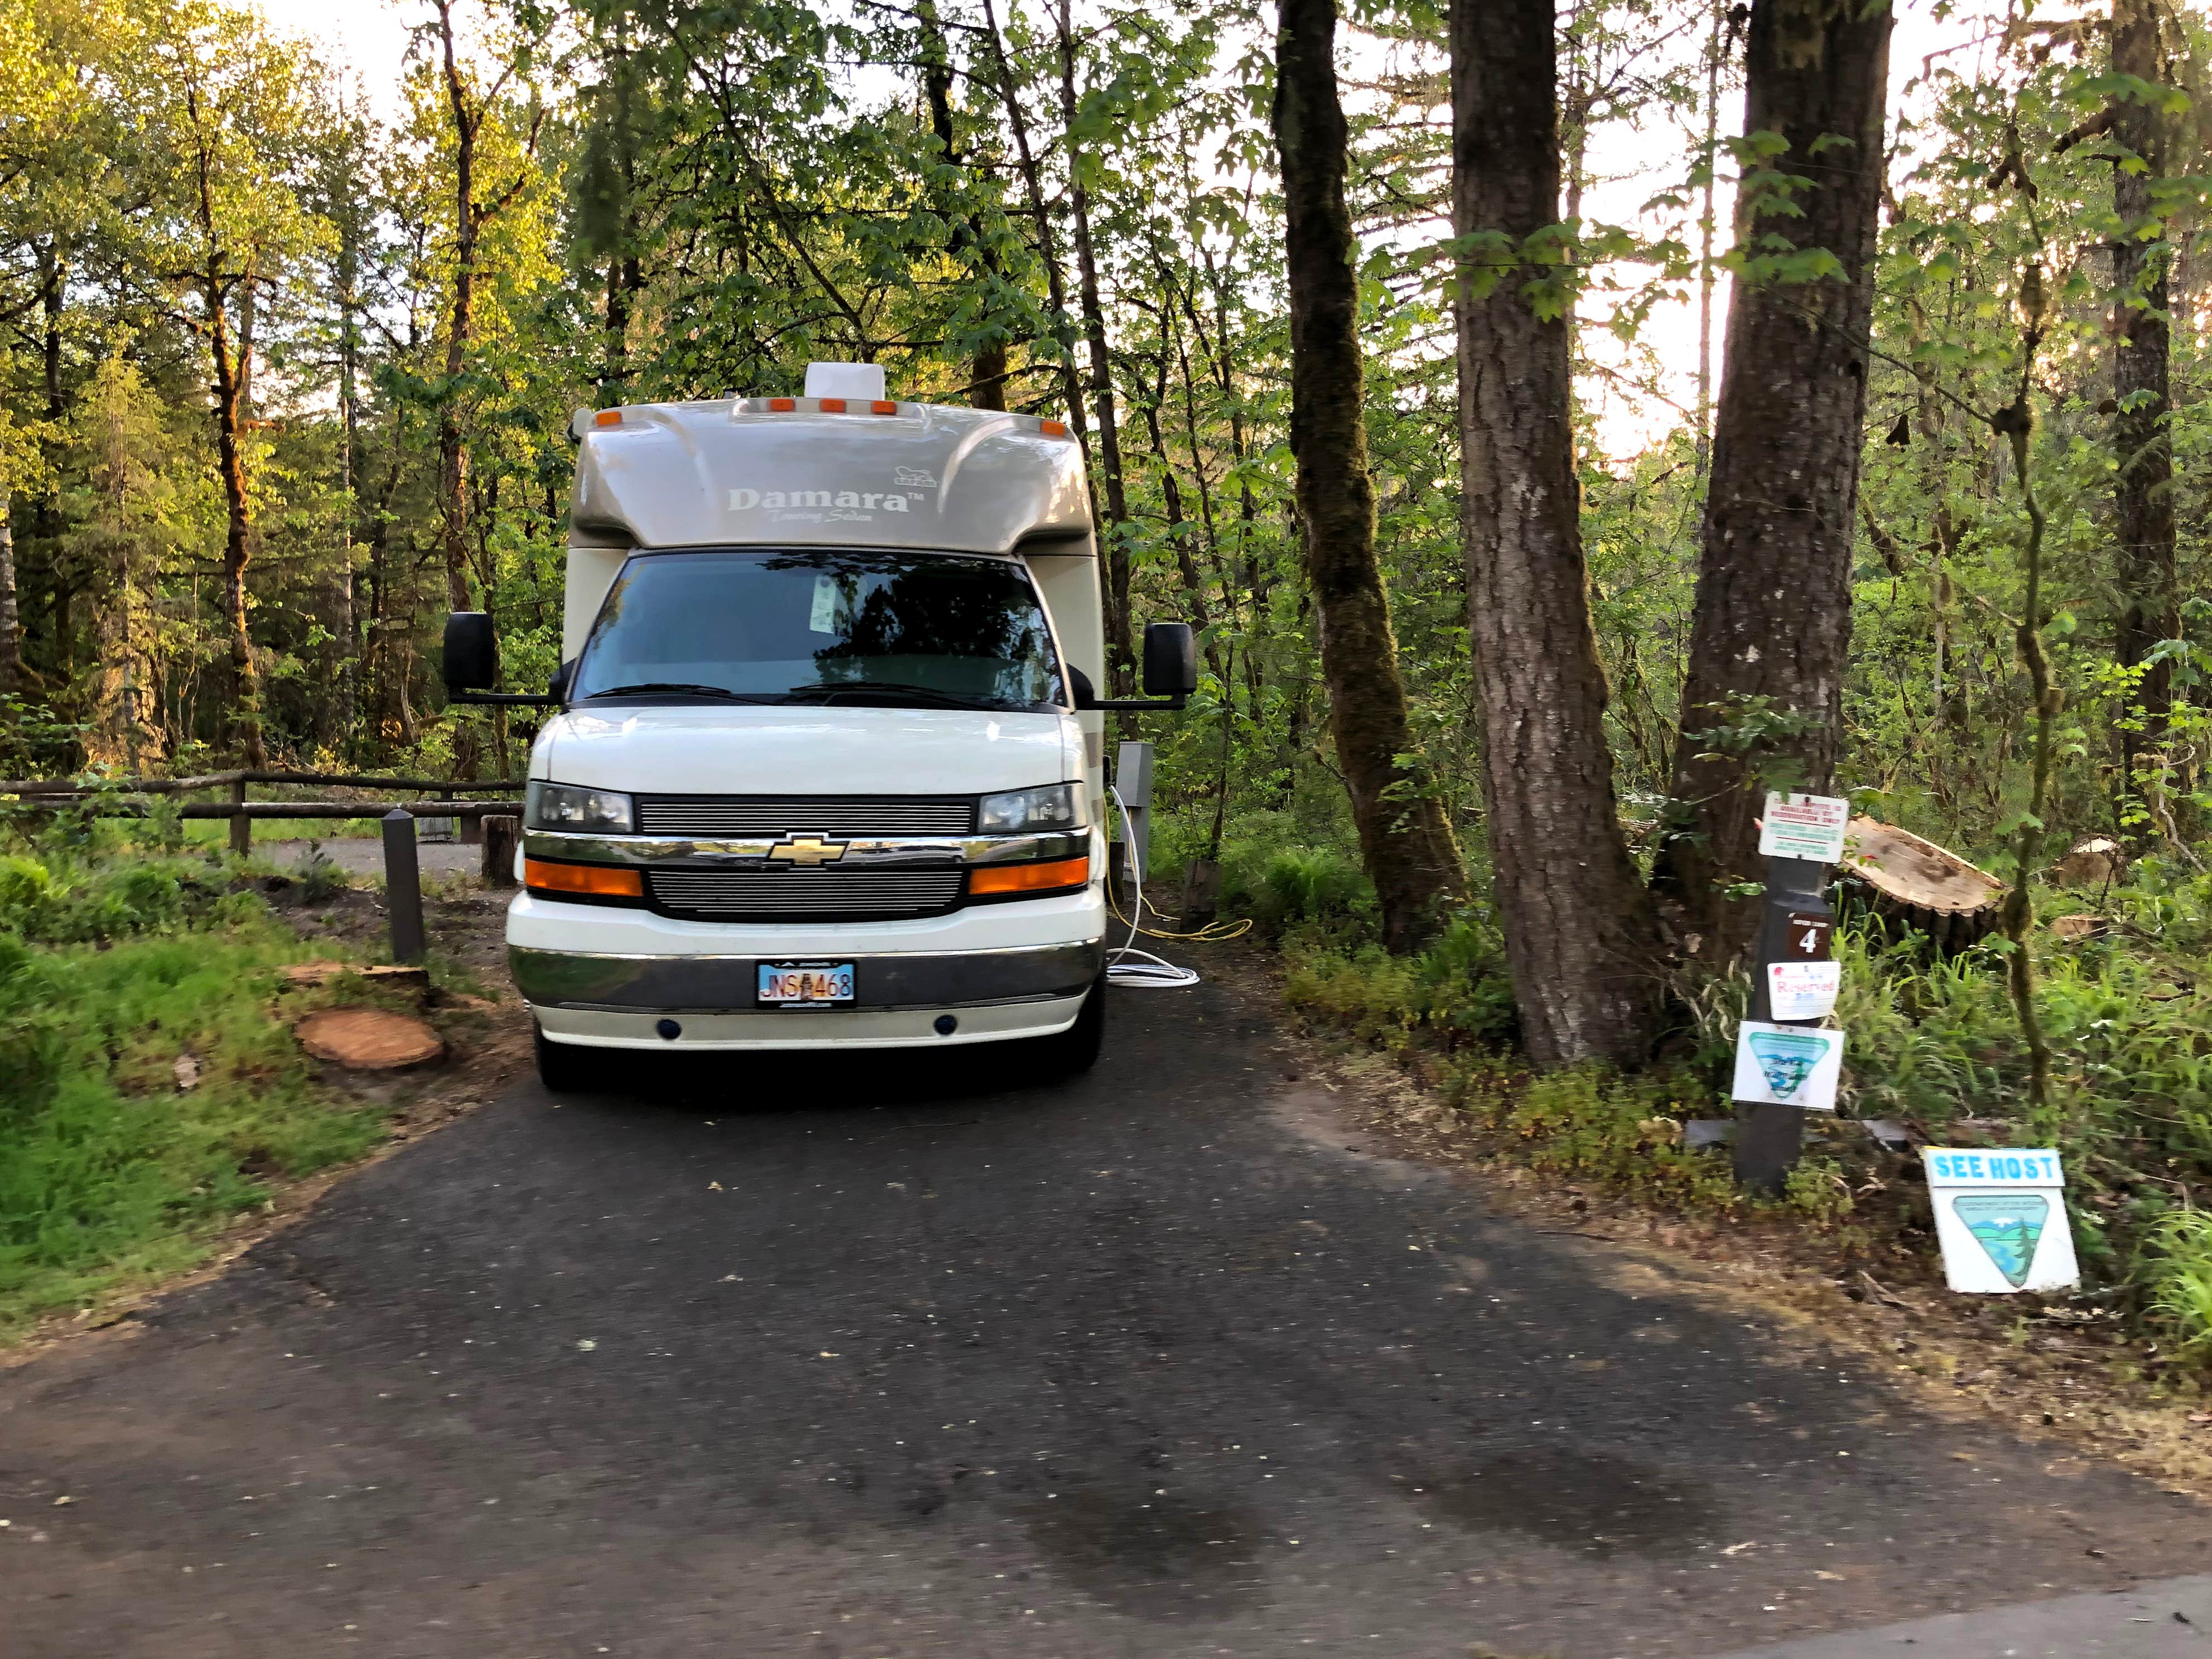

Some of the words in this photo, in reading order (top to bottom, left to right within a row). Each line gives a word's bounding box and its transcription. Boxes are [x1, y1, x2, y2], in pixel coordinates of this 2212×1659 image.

[728, 489, 909, 512] Damara
[1799, 929, 1816, 953] 4
[815, 973, 851, 997] 468
[1934, 1156, 1984, 1178] SEE
[1988, 1157, 2053, 1179] HOST
